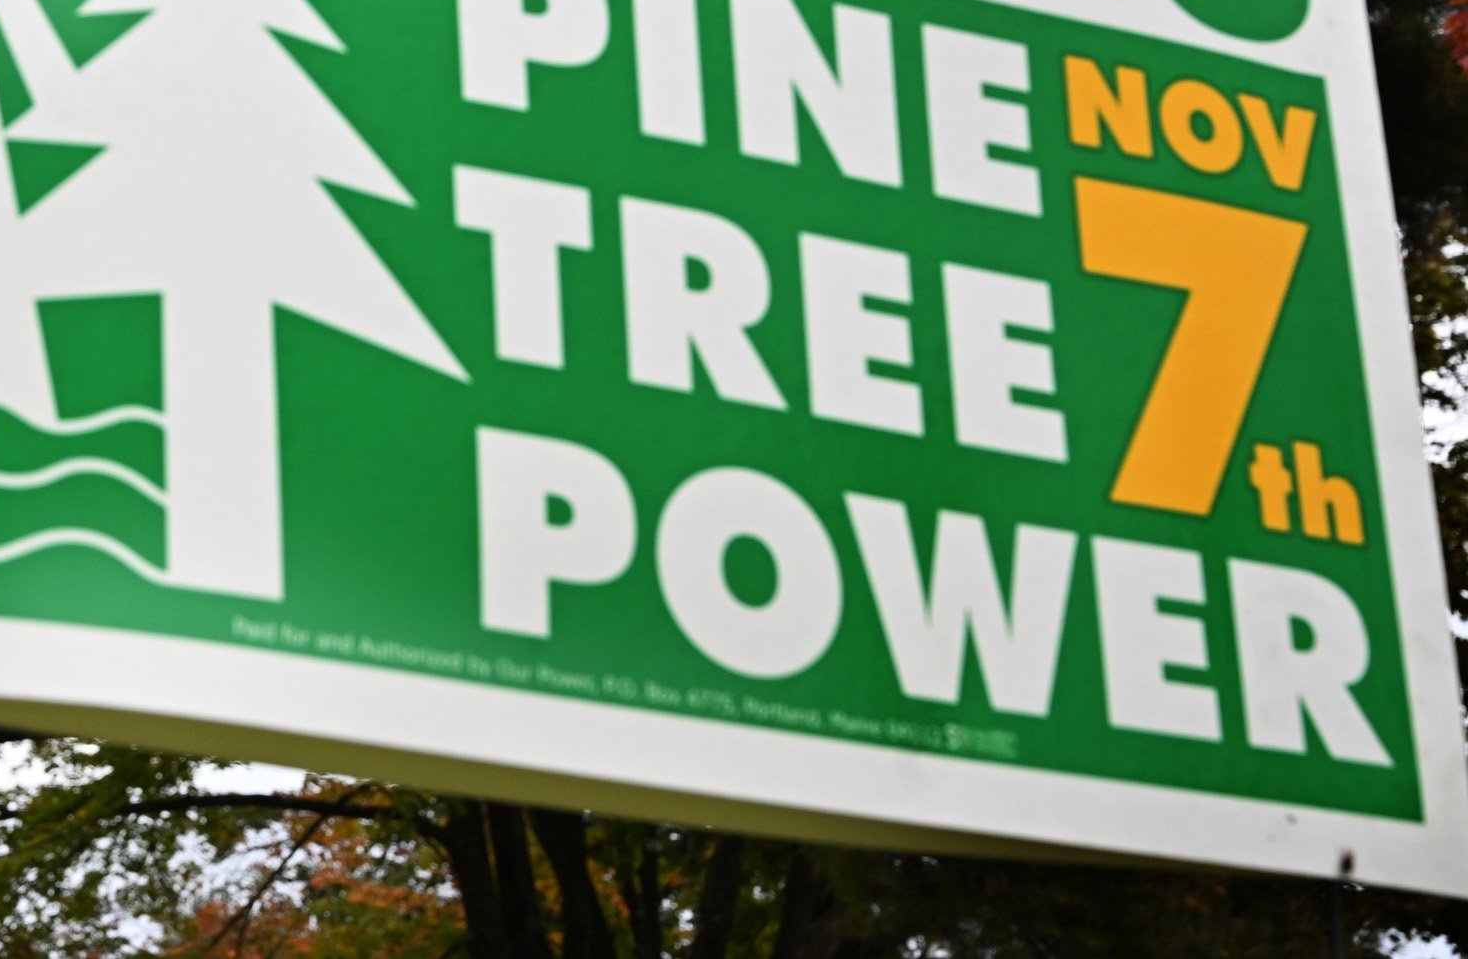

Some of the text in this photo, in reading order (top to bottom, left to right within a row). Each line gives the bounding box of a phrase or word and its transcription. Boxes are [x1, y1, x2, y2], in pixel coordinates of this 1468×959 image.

[1063, 53, 1317, 191] NOV
[452, 163, 1069, 464] TREE
[1073, 175, 1366, 546] 7th
[232, 615, 277, 643] Paid
[280, 619, 309, 648] for
[313, 632, 355, 656] and
[466, 650, 491, 680] by
[494, 656, 531, 682] Our
[644, 679, 681, 706] Box
[475, 425, 1396, 768] POWER
